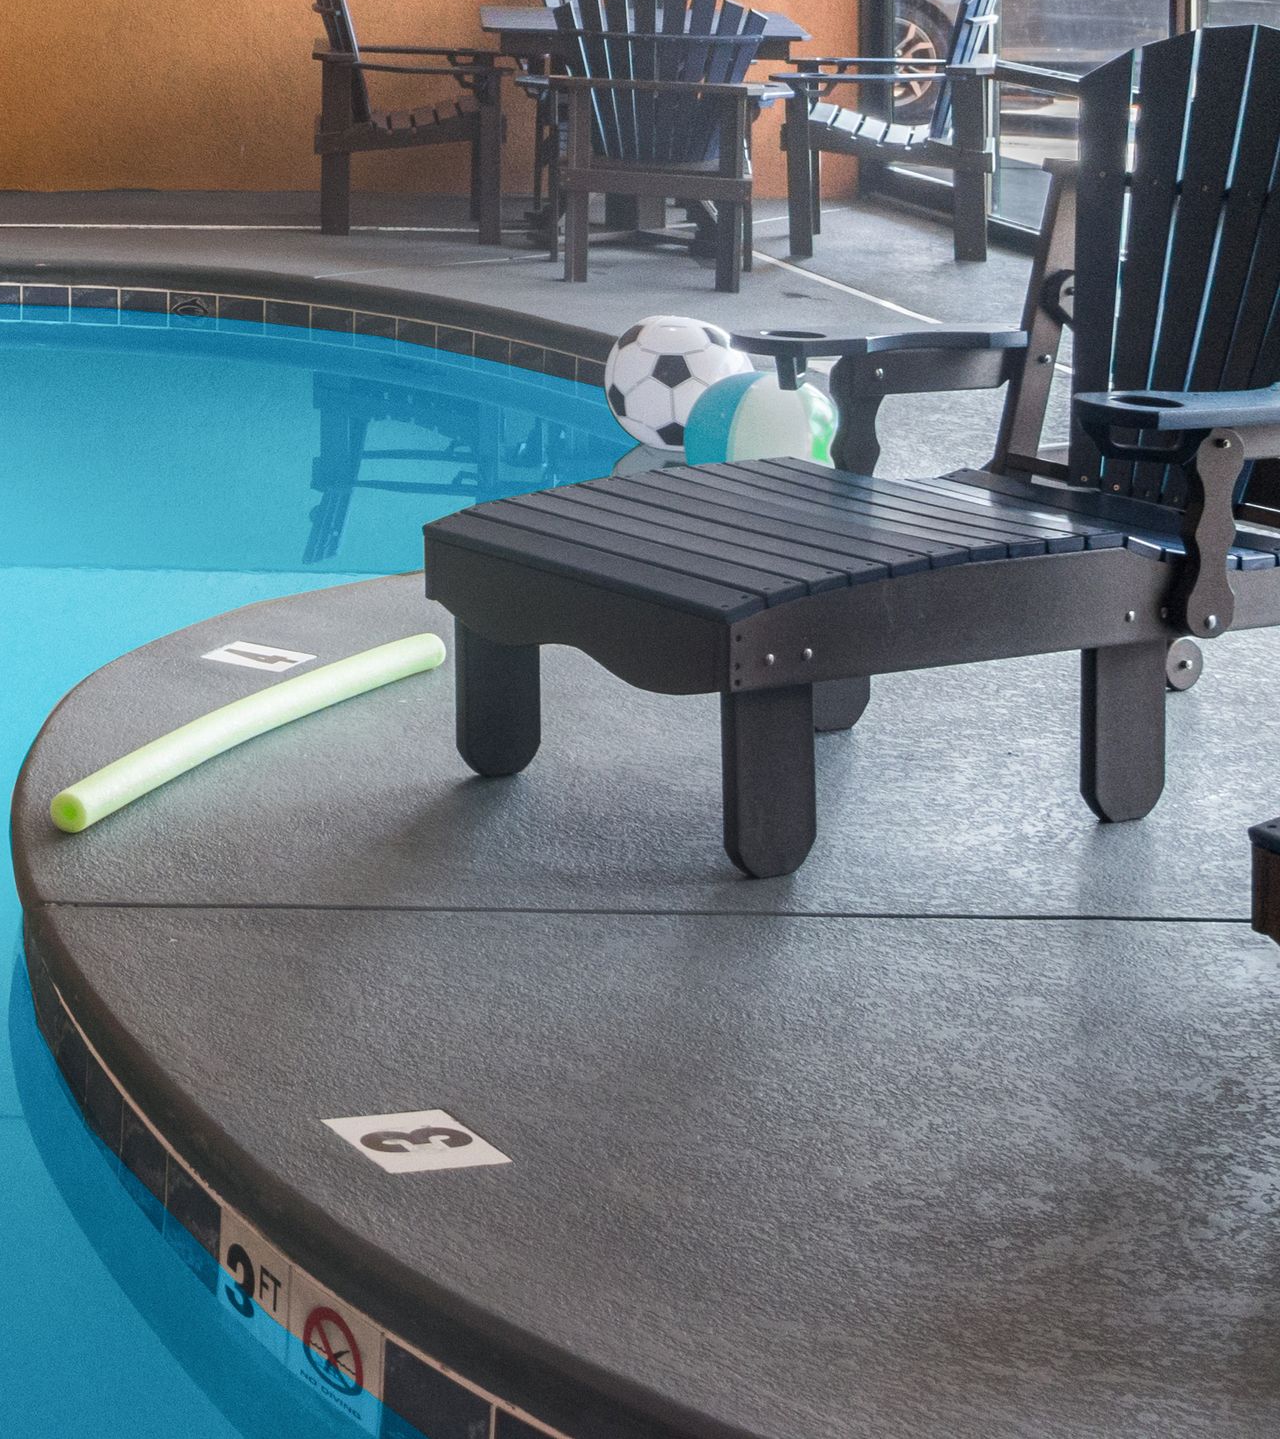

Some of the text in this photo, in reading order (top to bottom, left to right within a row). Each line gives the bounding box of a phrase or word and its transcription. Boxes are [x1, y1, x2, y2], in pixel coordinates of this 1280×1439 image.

[224, 648, 299, 665] 4
[360, 1127, 473, 1153] 3
[225, 1243, 282, 1318] 3 FT
[301, 1369, 361, 1420] NO DIVING
